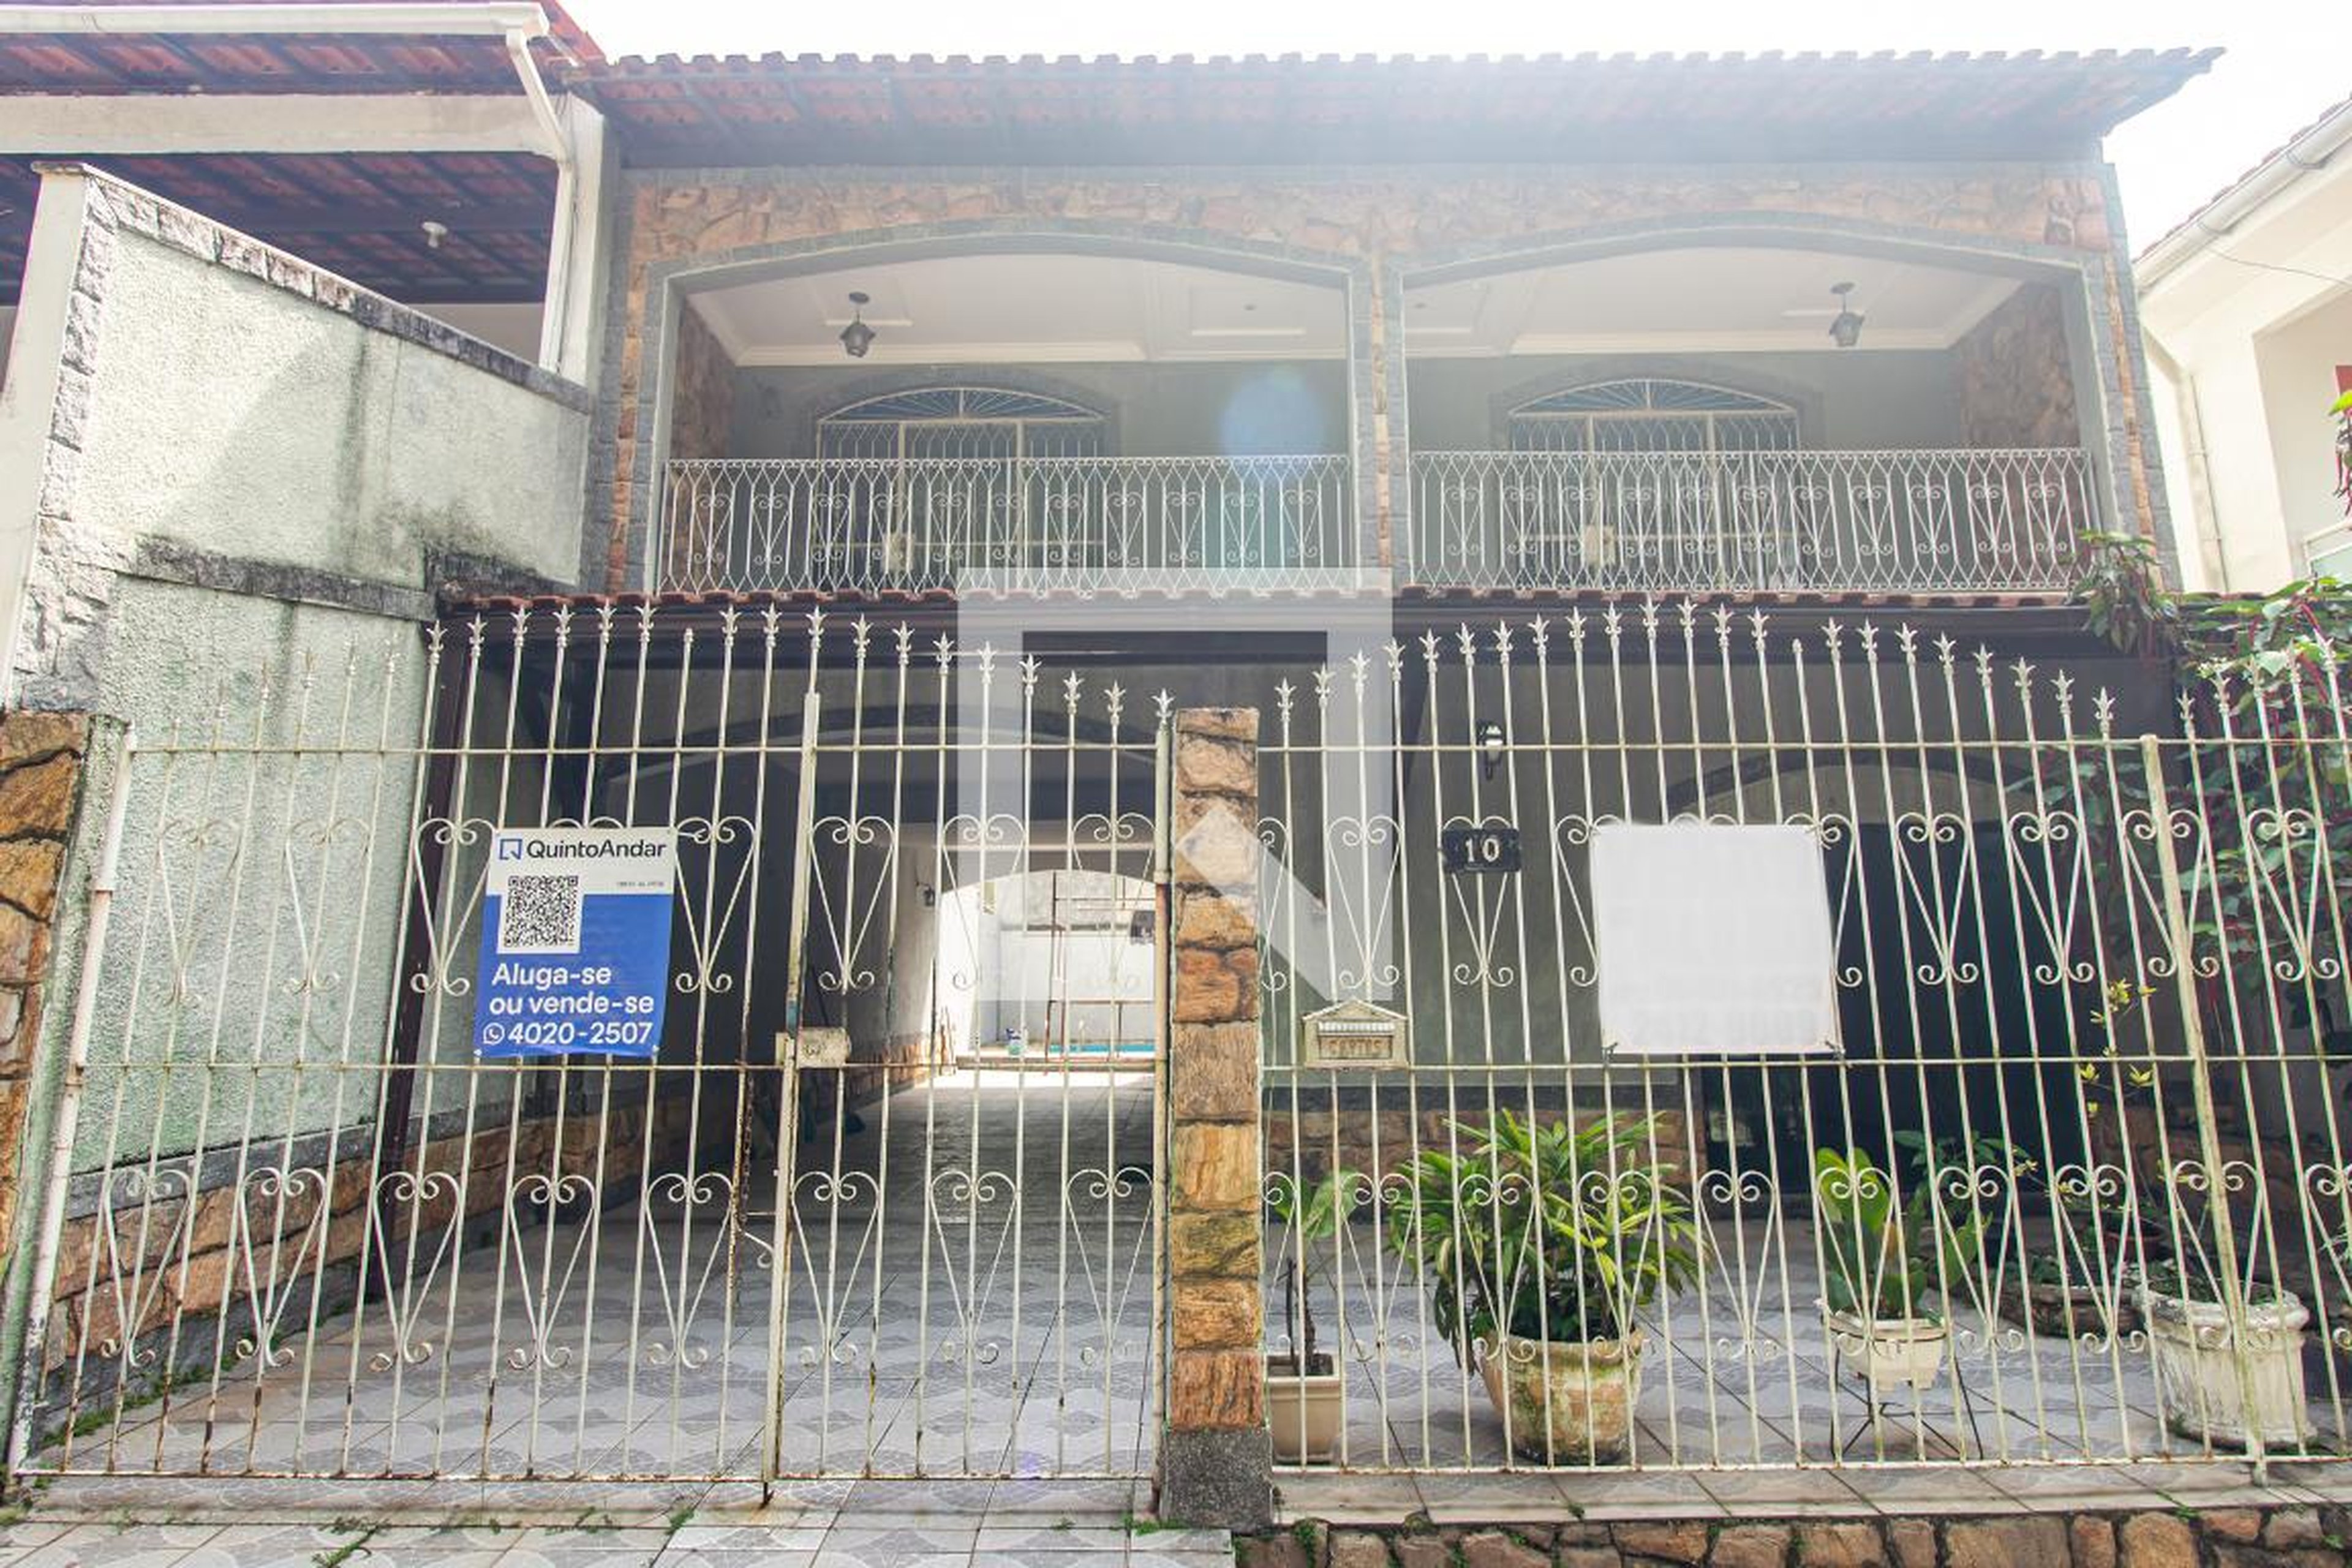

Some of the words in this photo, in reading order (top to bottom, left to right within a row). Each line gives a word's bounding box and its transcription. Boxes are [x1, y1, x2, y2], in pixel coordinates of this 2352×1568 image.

[527, 839, 666, 861] QuintoAndar
[1464, 837, 1499, 862] 10
[492, 963, 612, 991] Aluga-se
[489, 998, 526, 1014] ou
[529, 991, 655, 1014] vende-se
[508, 1022, 653, 1045] 4020-2507
